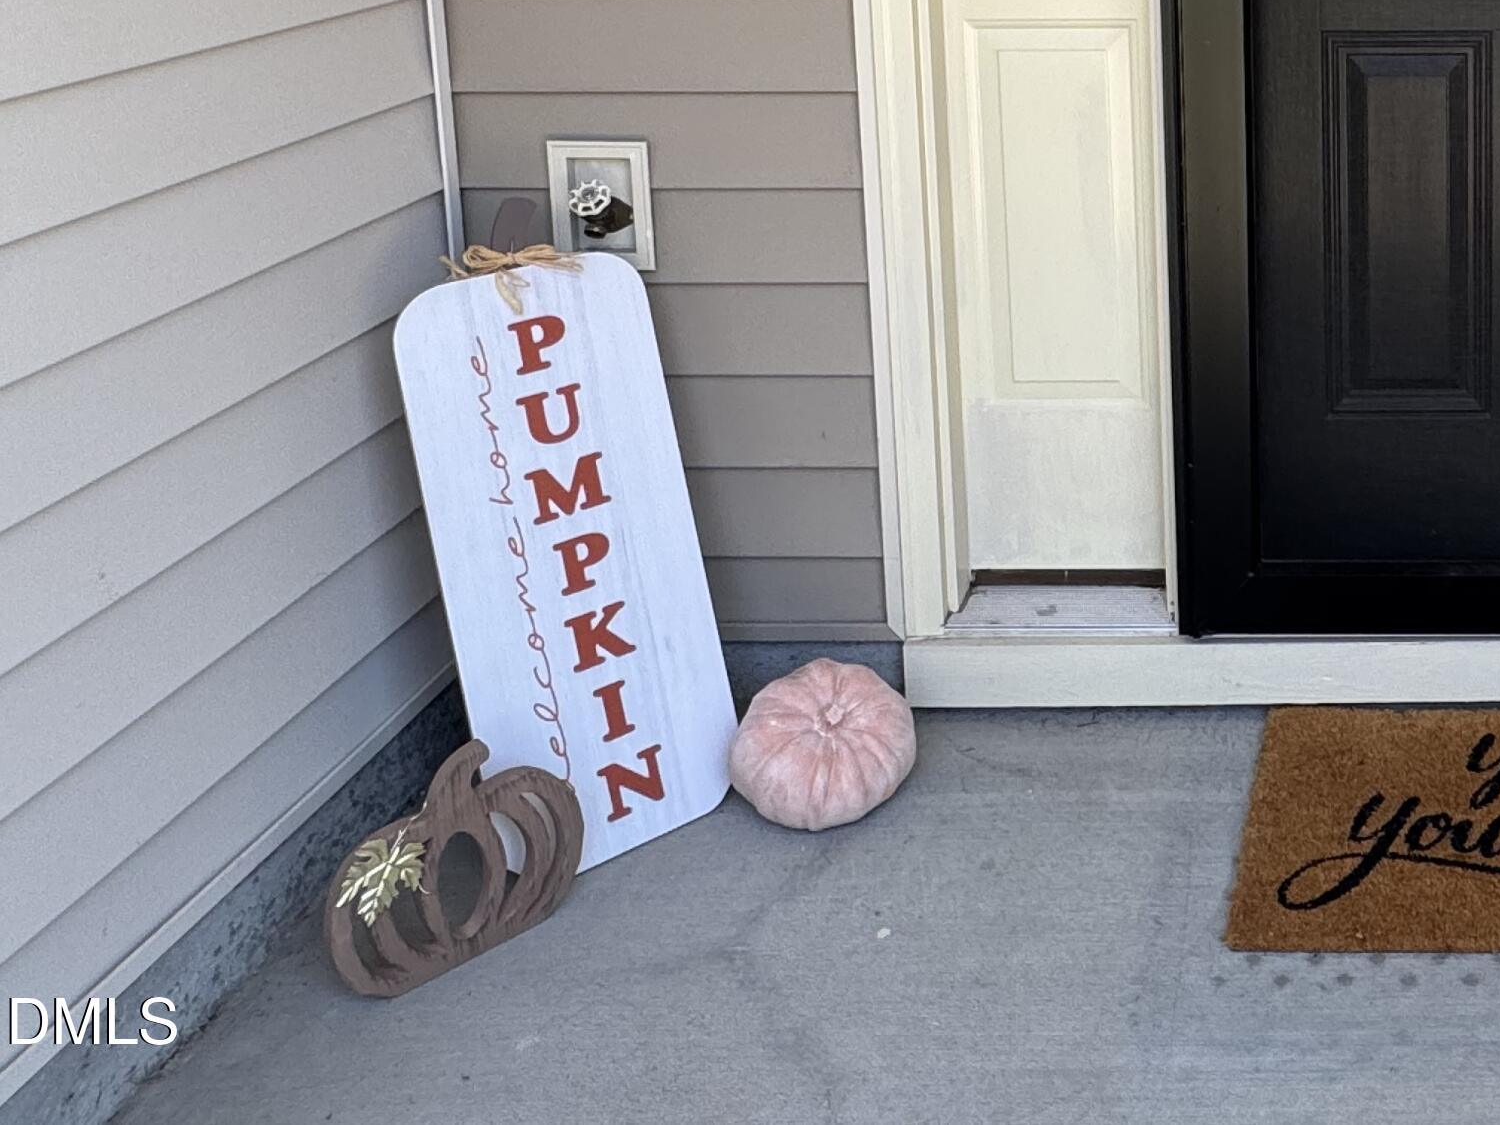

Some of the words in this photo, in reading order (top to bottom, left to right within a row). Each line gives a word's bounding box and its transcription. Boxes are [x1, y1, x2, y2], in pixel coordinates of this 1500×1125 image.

[470, 335, 514, 505] home
[507, 315, 665, 822] PUMPKIN
[507, 516, 574, 783] elcome
